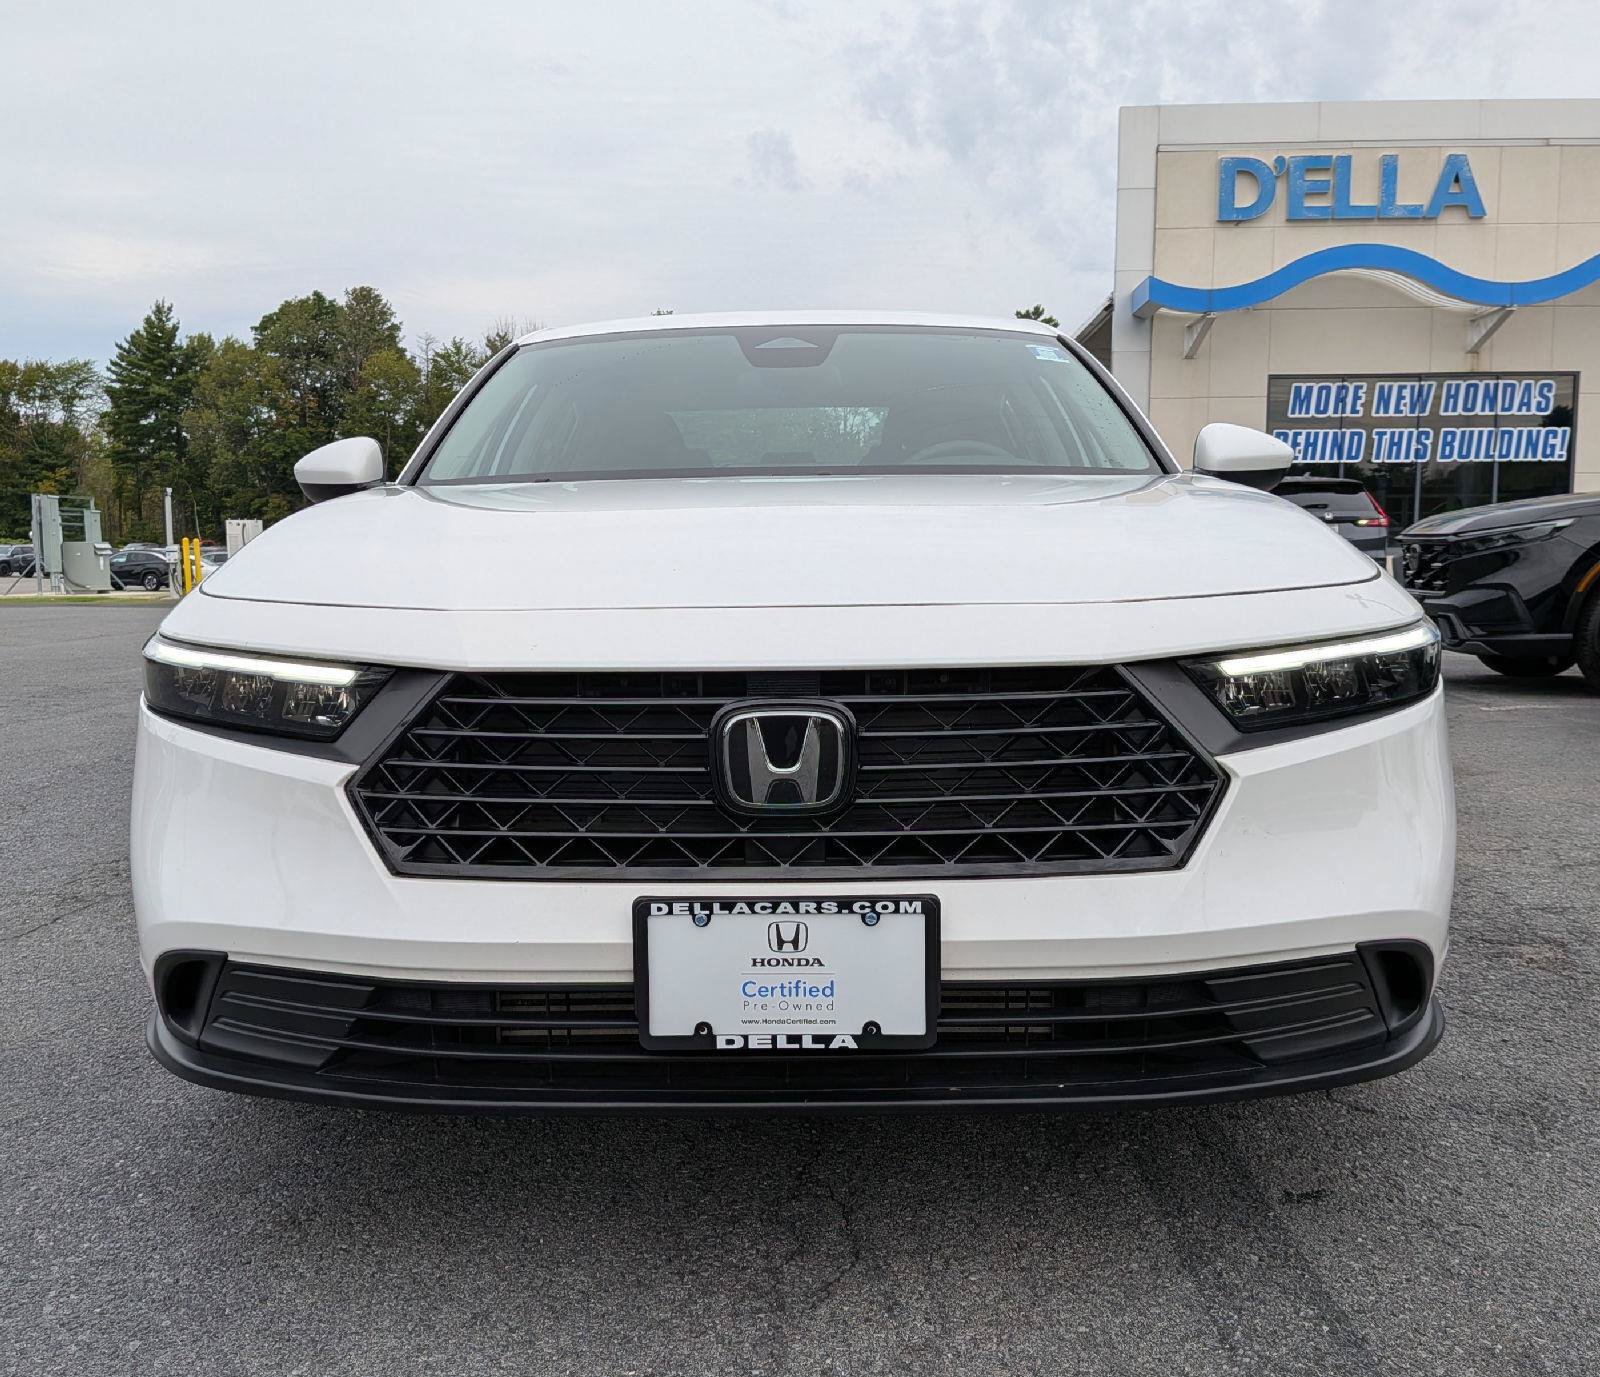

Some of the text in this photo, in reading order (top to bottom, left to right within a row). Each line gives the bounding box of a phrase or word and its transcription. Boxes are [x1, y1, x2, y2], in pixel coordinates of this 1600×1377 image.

[1217, 153, 1487, 223] D'ELLA
[1288, 380, 1556, 417] MORE NEW HONDAS
[1371, 428, 1434, 463] THIS
[1437, 427, 1571, 462] BUILDING!
[650, 901, 922, 916] DELLACARS.COM
[750, 957, 825, 968] HONDA
[741, 979, 835, 998] Certified
[743, 1000, 834, 1011] Pre-Owned
[716, 1034, 859, 1049] DELLA
